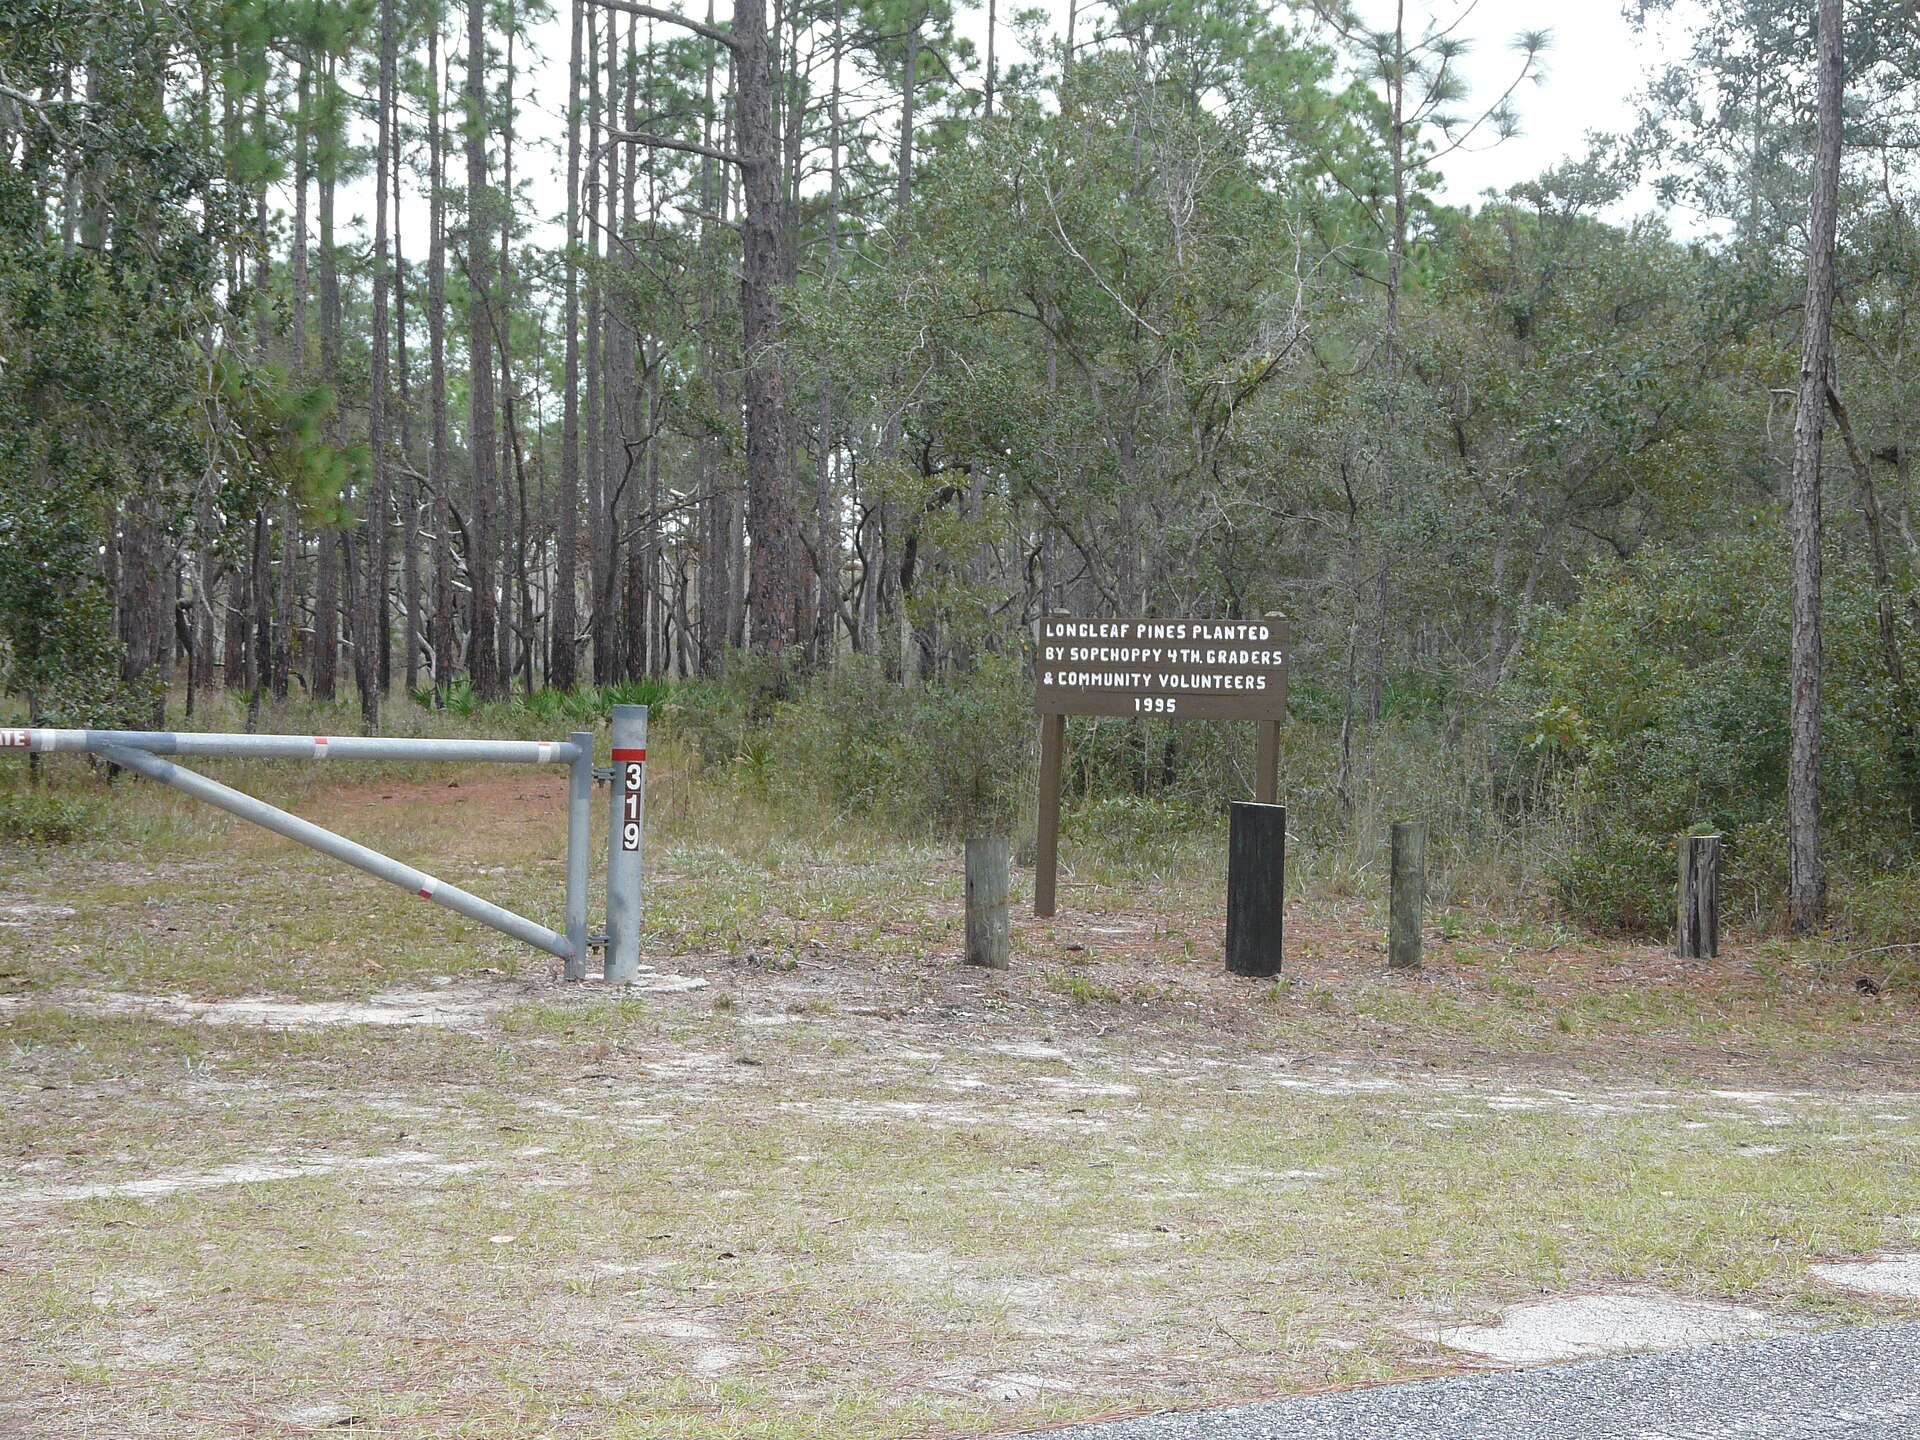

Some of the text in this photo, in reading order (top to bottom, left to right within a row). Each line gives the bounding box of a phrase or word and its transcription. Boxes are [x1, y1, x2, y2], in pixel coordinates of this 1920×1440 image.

[1046, 623, 1270, 641] LONGLEAF PINES PLANTED
[1045, 647, 1064, 661] BY
[1070, 647, 1162, 662] SOPCHOPPY
[1206, 650, 1282, 665] GRADERS
[1043, 671, 1266, 689] & COMMUNITY VOLUNTEERS
[1134, 697, 1177, 713] 1995
[623, 763, 642, 850] 319
